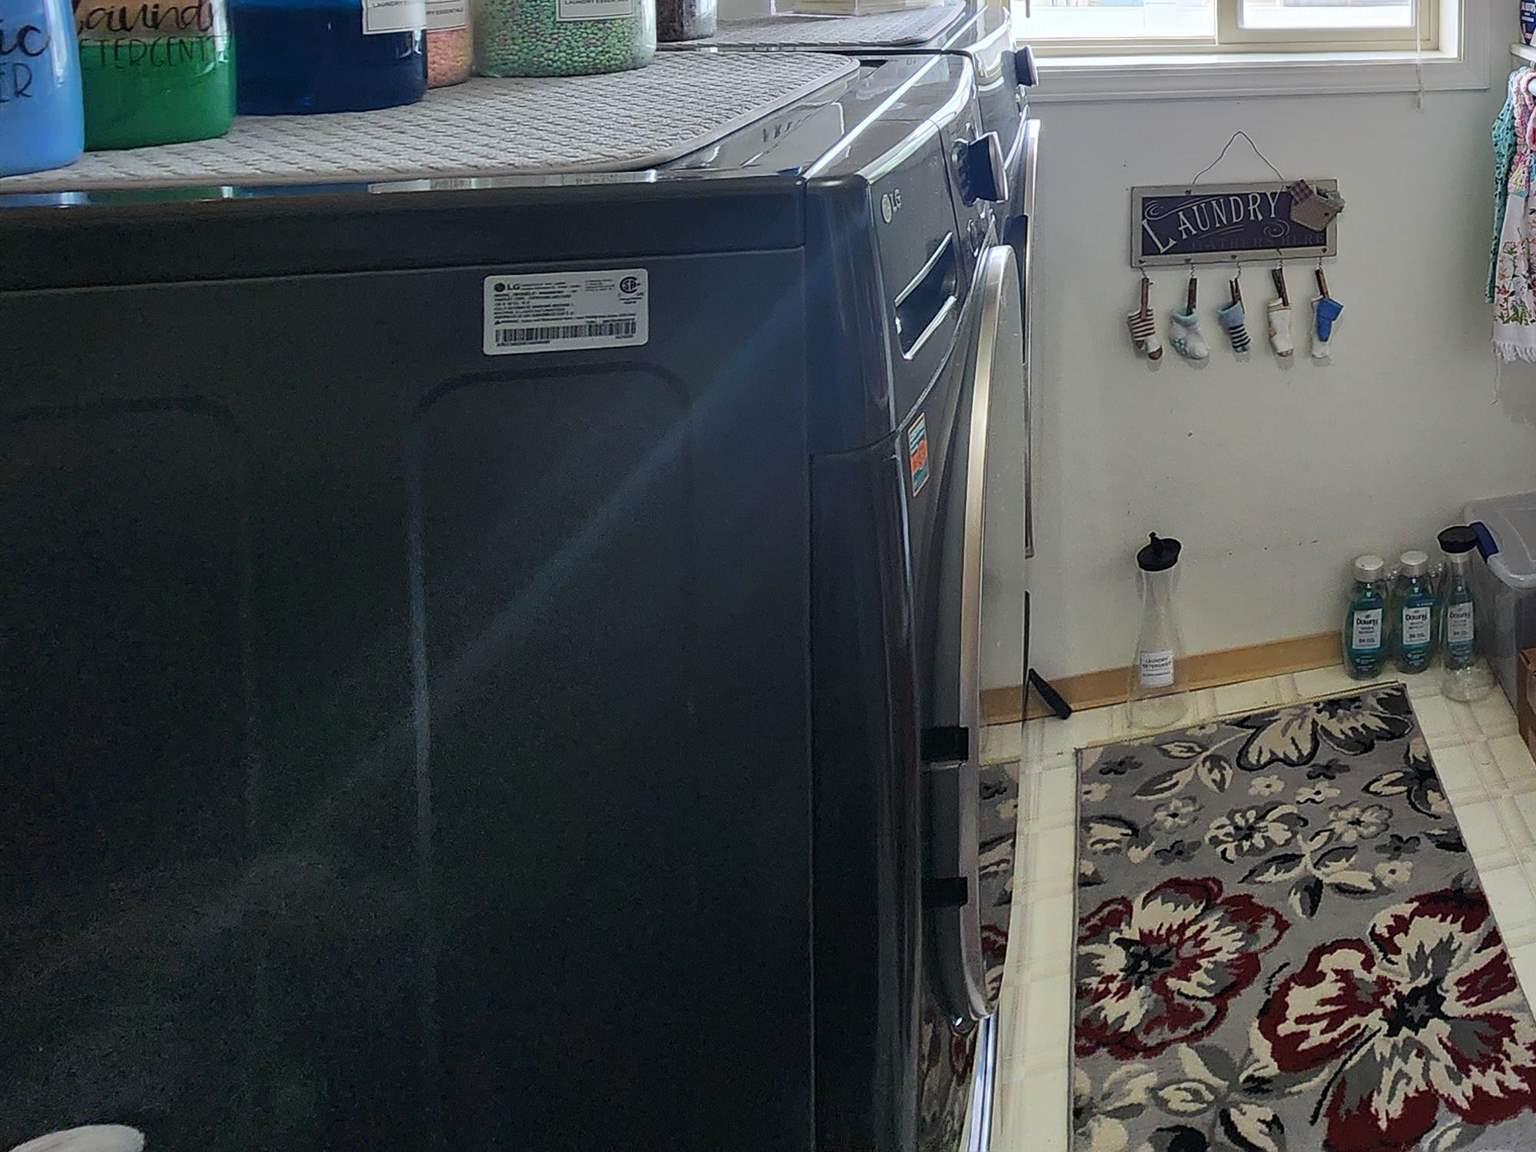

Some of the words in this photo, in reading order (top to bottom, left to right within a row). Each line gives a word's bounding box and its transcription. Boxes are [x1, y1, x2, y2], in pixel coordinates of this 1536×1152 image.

[80, 37, 222, 70] ETERGENT
[1142, 187, 1282, 255] LAUNDRY
[506, 283, 521, 292] LG
